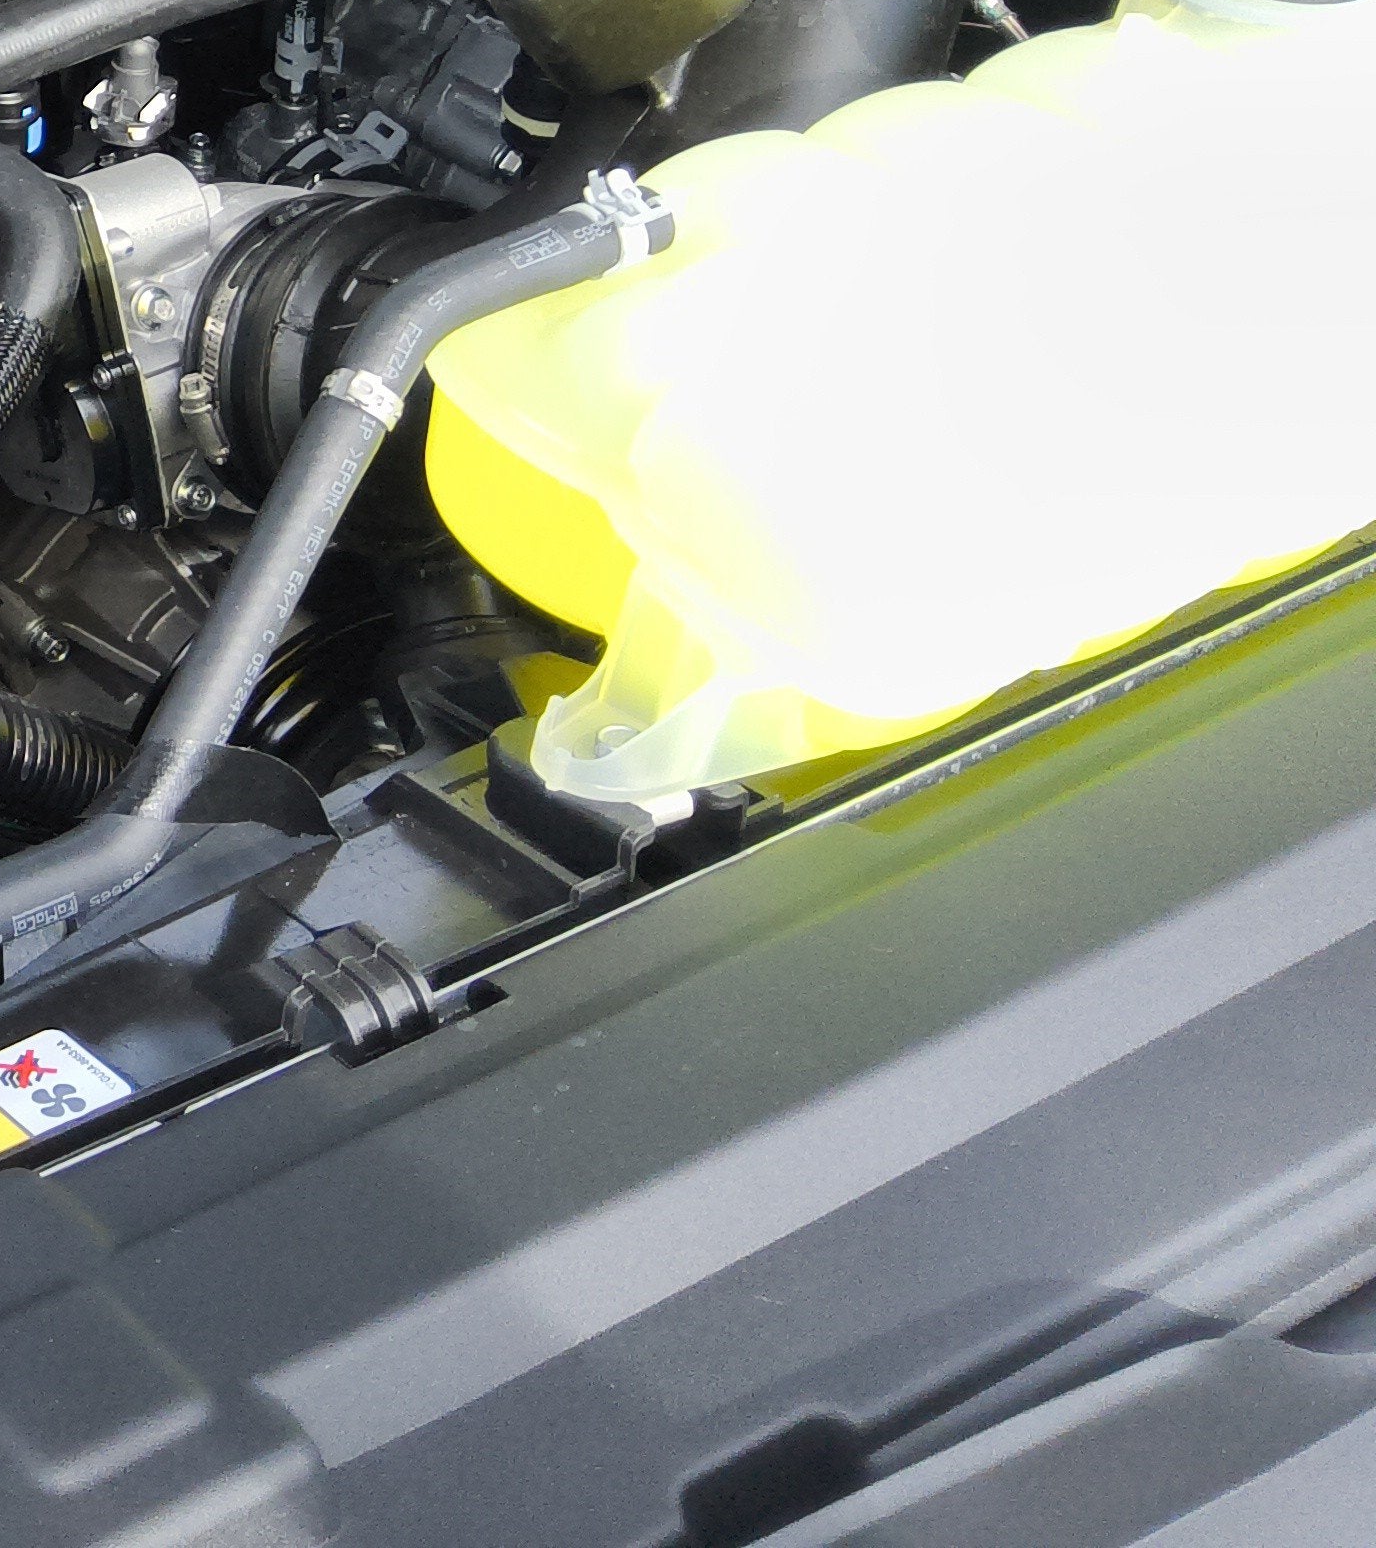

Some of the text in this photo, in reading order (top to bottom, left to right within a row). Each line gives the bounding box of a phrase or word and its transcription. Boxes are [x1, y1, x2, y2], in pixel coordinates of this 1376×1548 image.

[296, 523, 326, 564] MEX
[259, 627, 276, 644] C
[12, 898, 77, 935] FoMoCo
